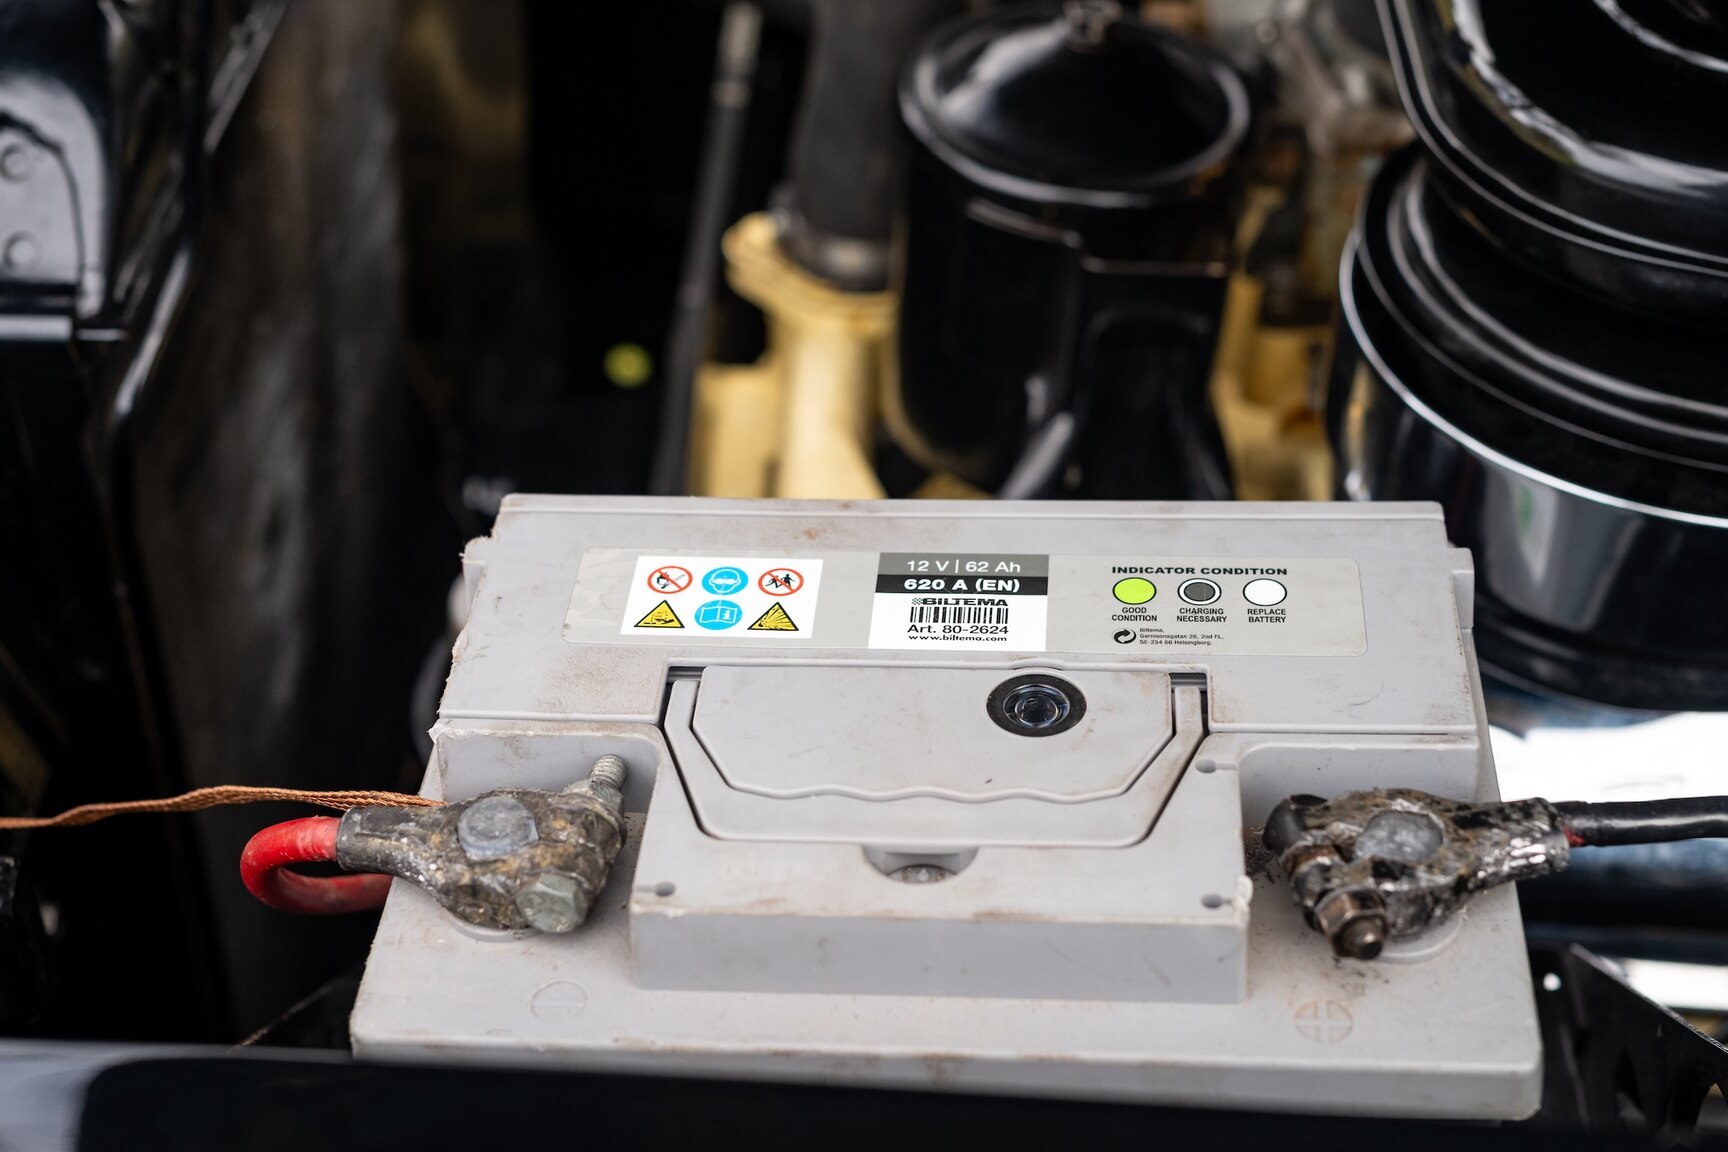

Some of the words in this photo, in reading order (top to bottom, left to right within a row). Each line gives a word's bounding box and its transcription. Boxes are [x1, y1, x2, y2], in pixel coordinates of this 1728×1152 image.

[907, 560, 929, 572] 12
[935, 560, 950, 572] V
[965, 560, 988, 573] 62
[994, 560, 1021, 573] Ah
[1112, 566, 1196, 575] INDICATOR
[1200, 567, 1288, 576] CONDITION
[904, 578, 946, 590] 620
[952, 579, 968, 590] A
[975, 578, 1021, 592] (EN)
[922, 598, 1009, 606] BILTEMA
[1246, 608, 1286, 616] REPLACE
[1111, 614, 1158, 622] CONDITION
[1176, 615, 1228, 623] NECESSARY
[1248, 616, 1287, 624] BATTERY
[906, 624, 937, 634] Art.
[942, 625, 1010, 635] 80-2624
